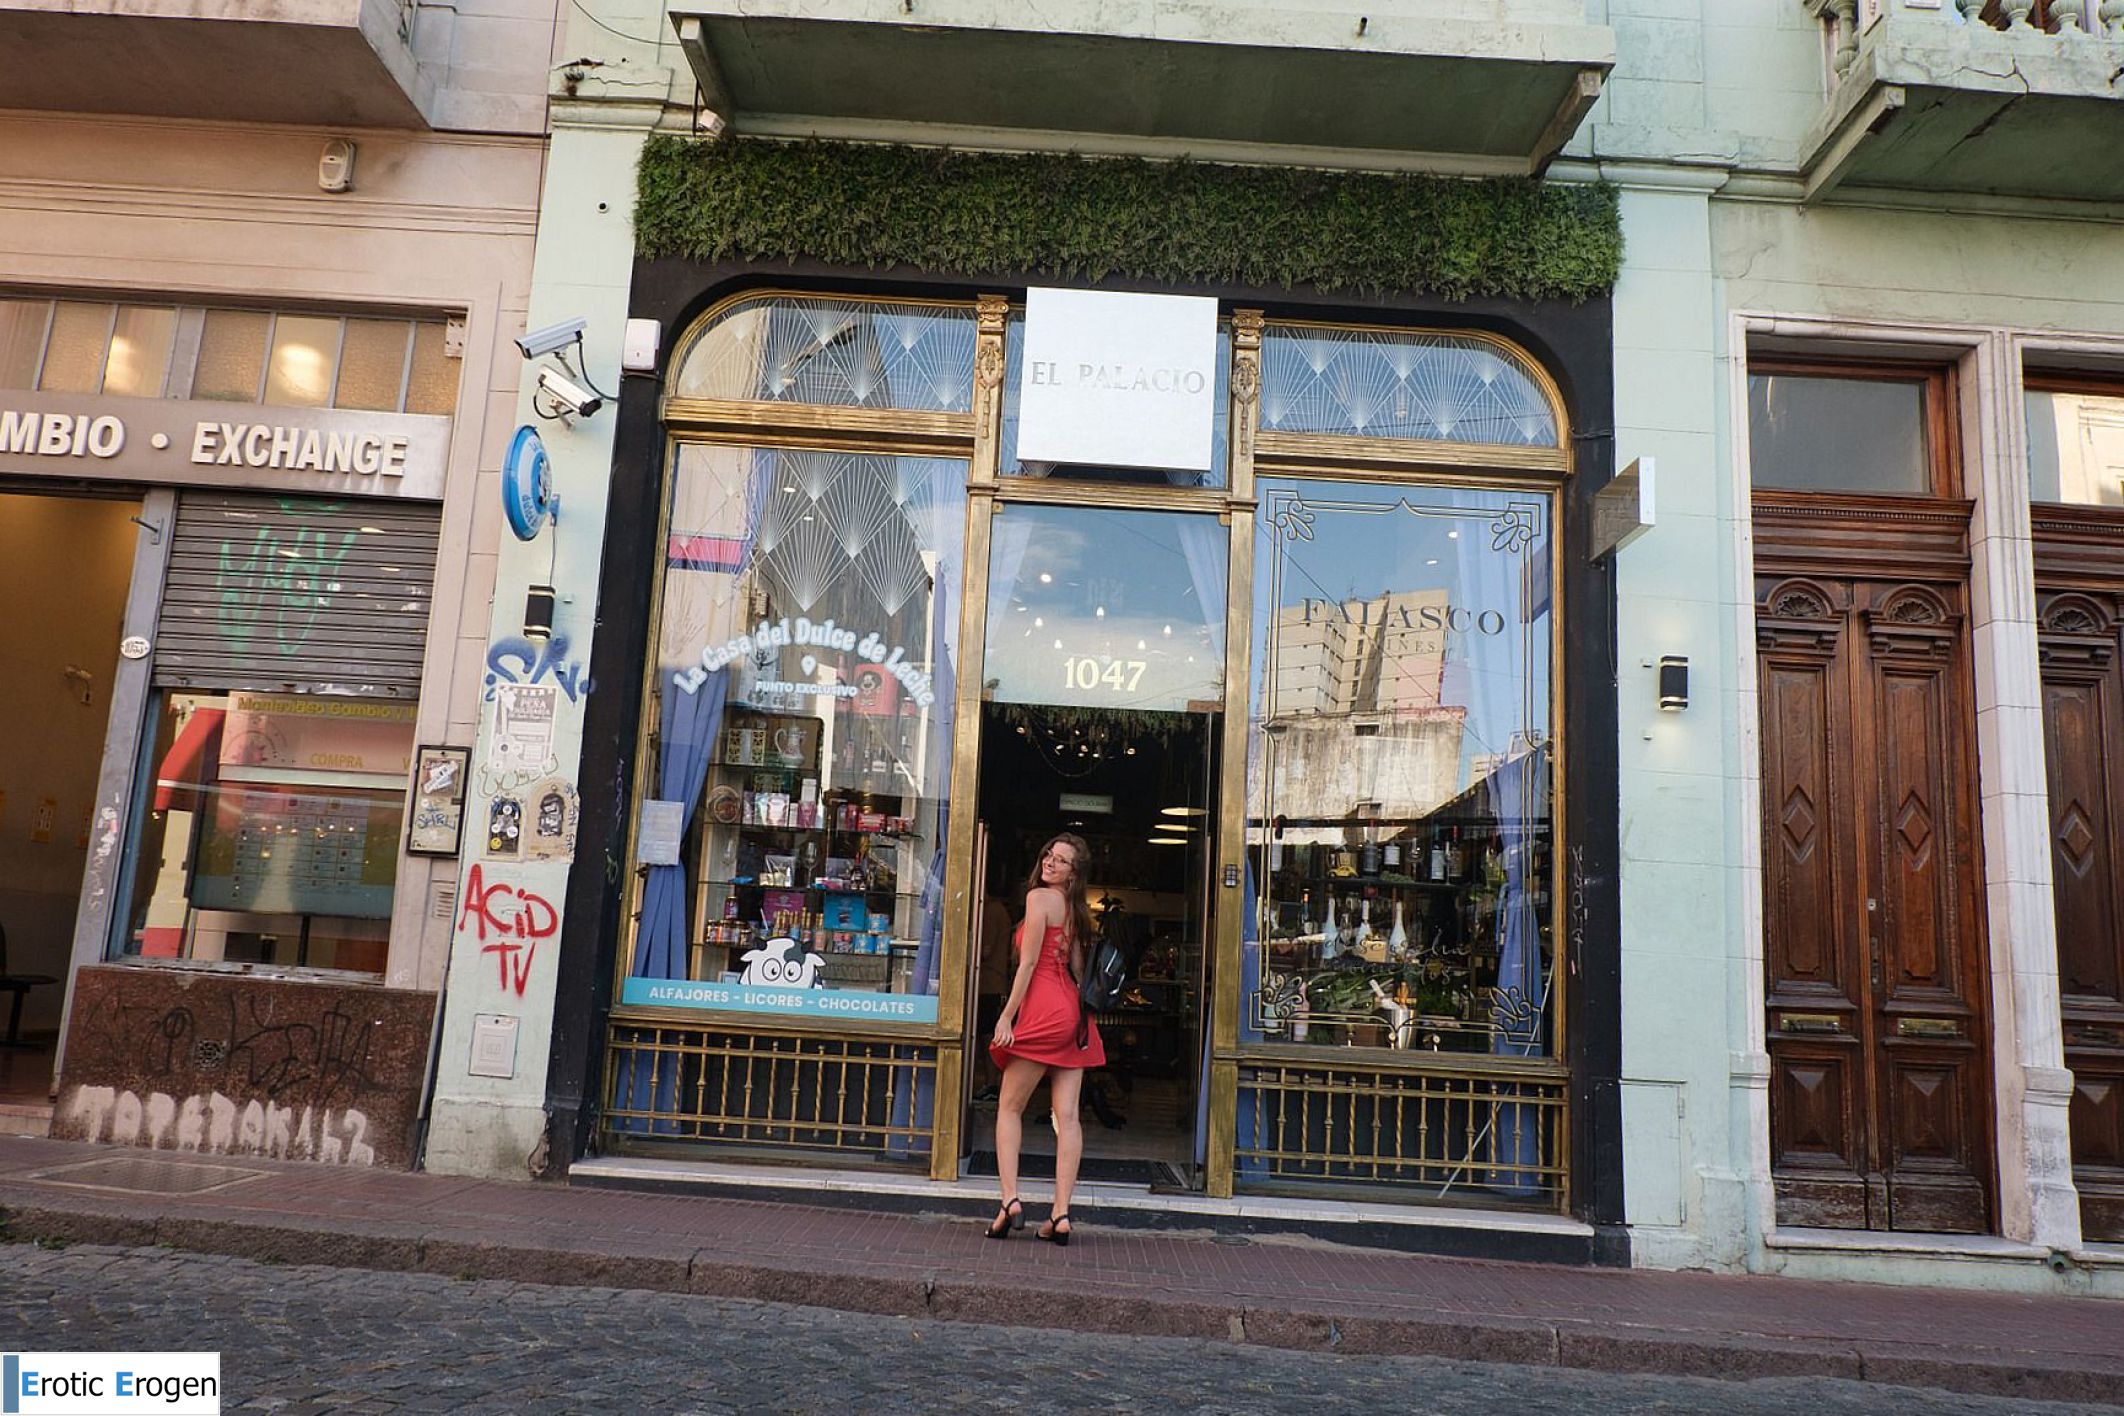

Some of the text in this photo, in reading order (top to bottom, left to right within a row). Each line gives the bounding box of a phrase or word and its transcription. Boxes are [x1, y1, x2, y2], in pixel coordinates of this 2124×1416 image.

[1031, 361, 1206, 395] EL PALACIO
[191, 421, 409, 476] EXCHANGE
[1301, 596, 1506, 636] FALASCO
[673, 617, 935, 708] La Casa del Dulce de Leche
[1063, 657, 1147, 692] 1047
[755, 681, 859, 698] PUNTO EXCLUSIVO
[310, 752, 363, 768] COMPRA
[482, 942, 536, 997] TV
[649, 986, 729, 1003] ALFAJORES
[744, 992, 803, 1008] LICORES
[818, 997, 915, 1014] CHOCOLATES
